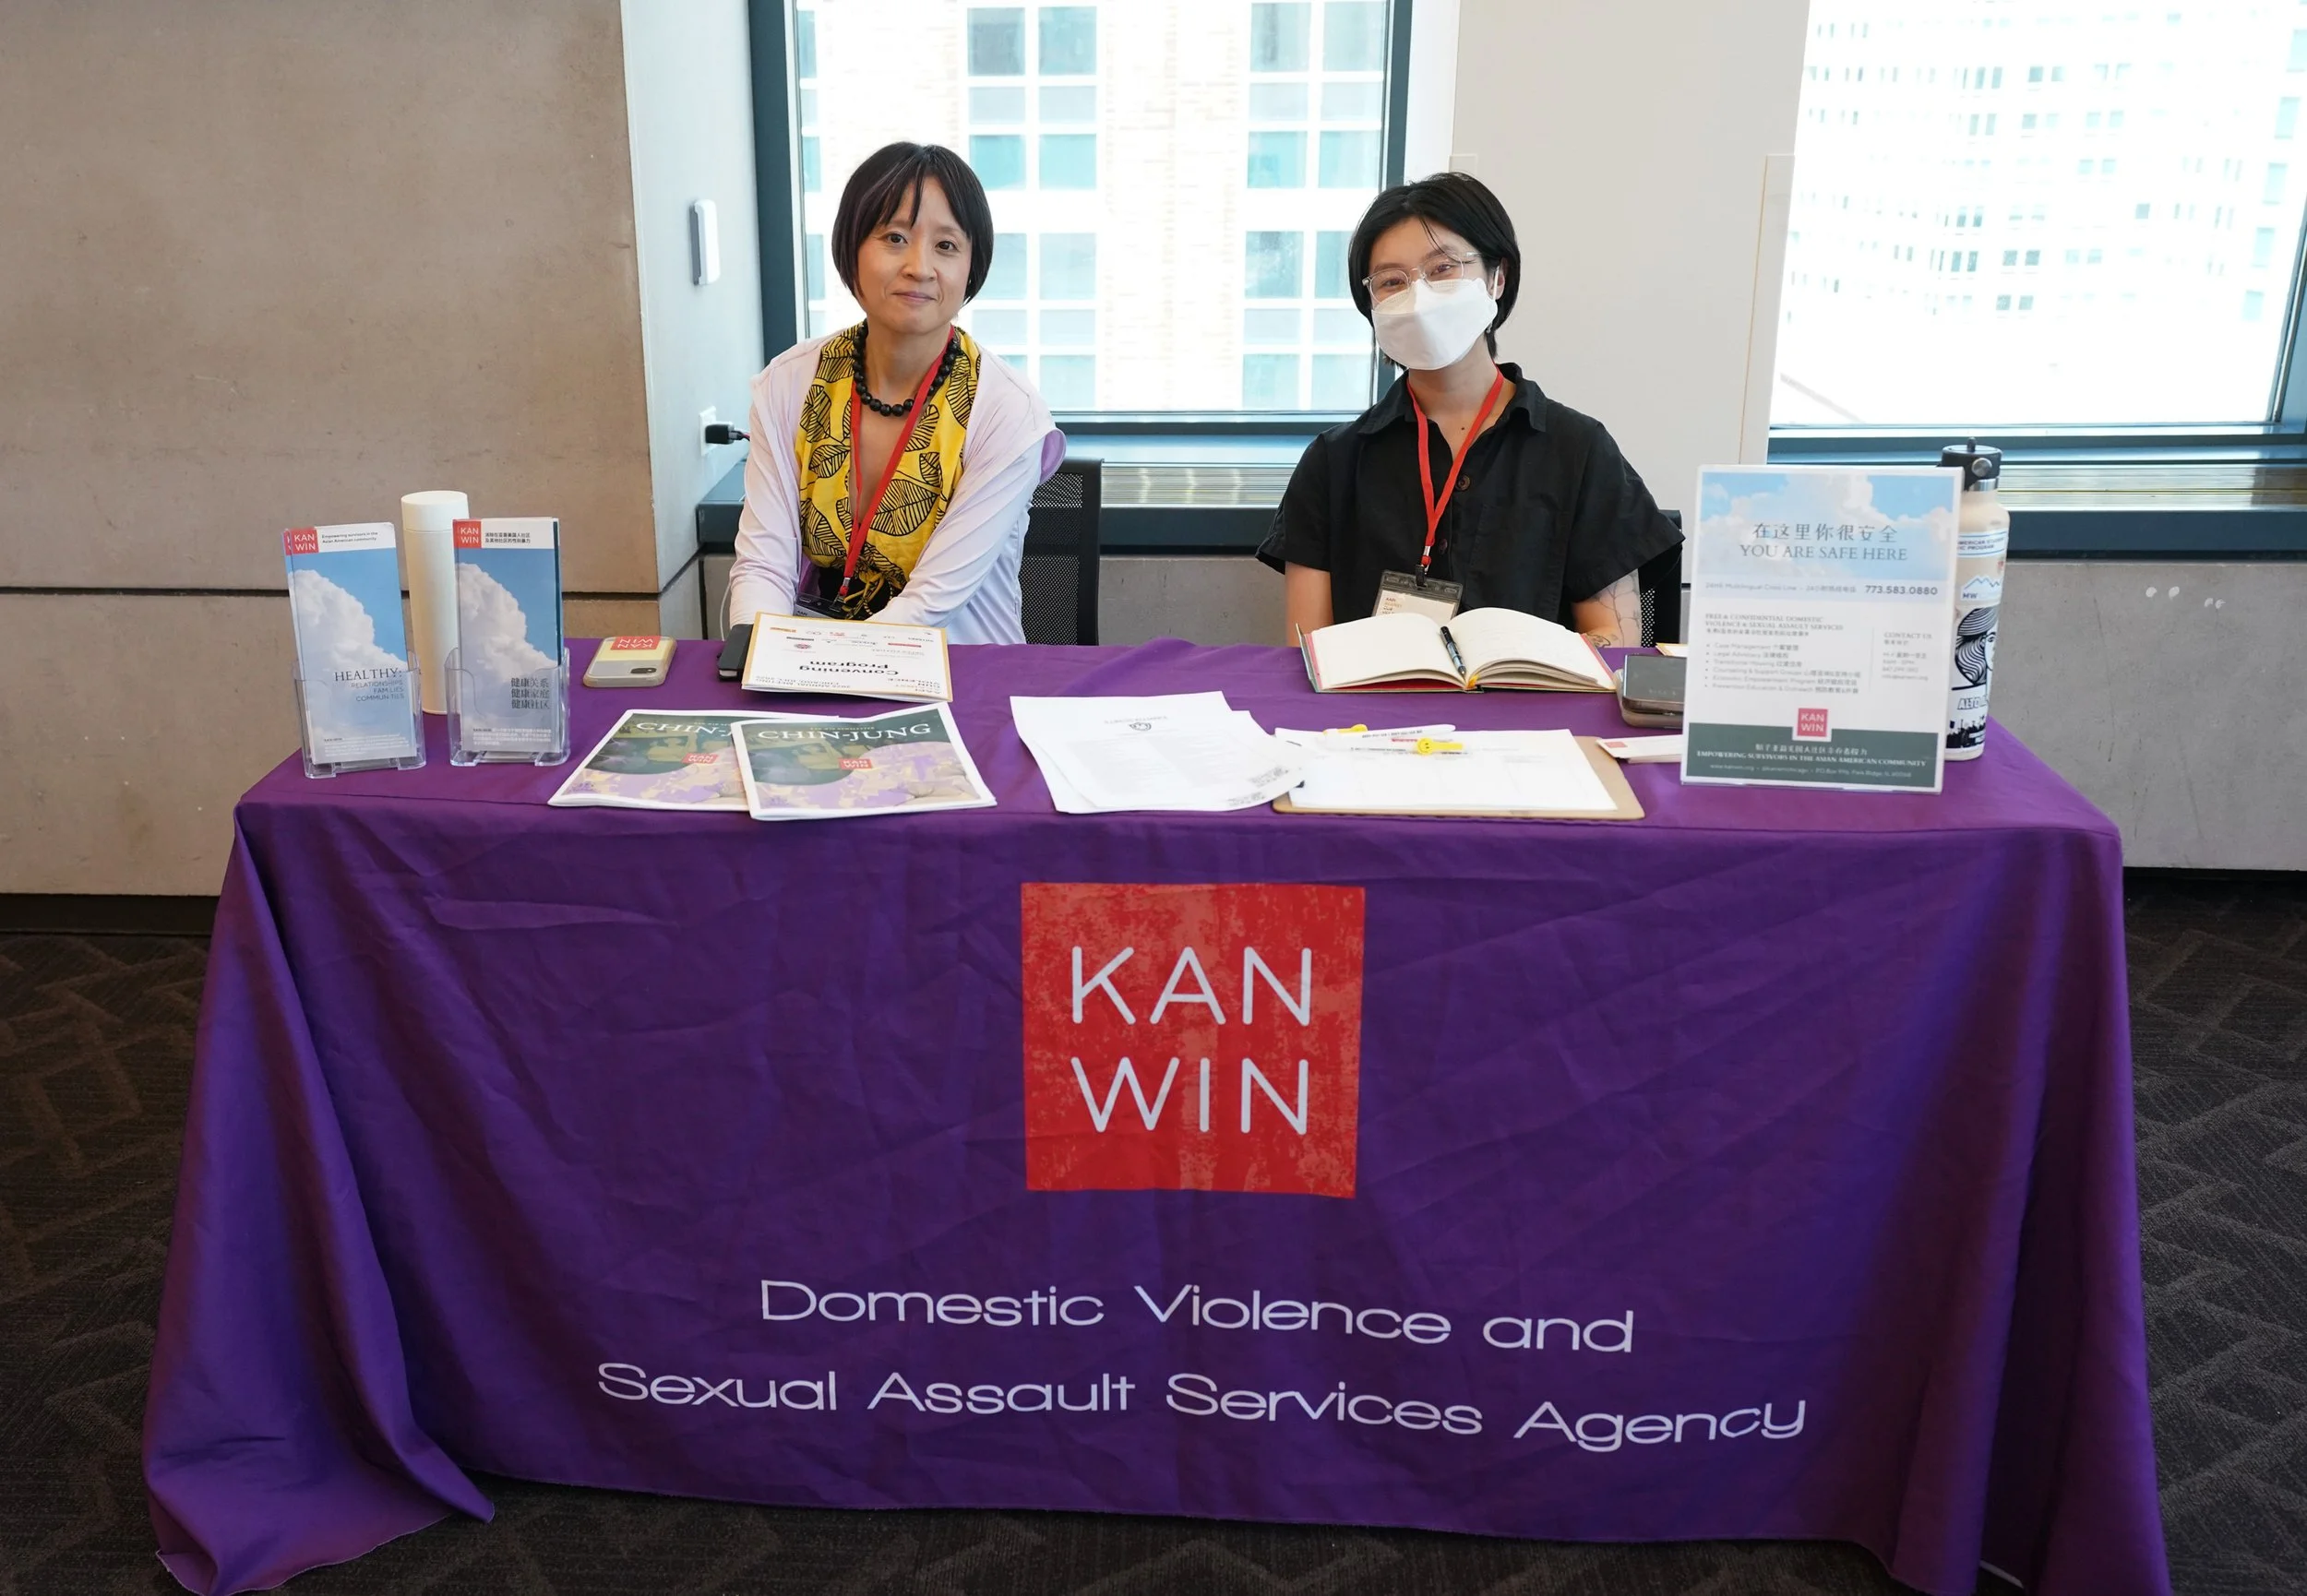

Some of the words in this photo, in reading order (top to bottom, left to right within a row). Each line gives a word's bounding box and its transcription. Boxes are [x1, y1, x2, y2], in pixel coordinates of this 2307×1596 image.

[460, 527, 479, 535] KAN
[1752, 523, 1898, 543] 在这里你很安全
[294, 533, 315, 542] KAN
[460, 536, 479, 544] WIN
[294, 543, 316, 552] WIN
[1739, 543, 1778, 558] YOU
[1782, 545, 1815, 559] ARE
[1819, 546, 1859, 560] SAFE
[1863, 547, 1907, 561] HERE
[1865, 584, 1938, 596] 773.583.0880
[799, 664, 899, 676] Convening
[809, 661, 889, 670] Program
[334, 667, 403, 682] HEALTHY:
[351, 679, 404, 689] RELATIONSHIPS
[510, 677, 549, 688] 健康关系
[510, 687, 550, 698] 健康家庭
[511, 698, 551, 709] 健康社区
[1800, 712, 1825, 722] KAN
[636, 722, 733, 737] CHIN-J
[758, 723, 931, 742] CHIN-JUNG
[1800, 722, 1824, 732] WIN
[1696, 750, 1747, 759] EMPOWERING
[1747, 752, 1788, 762] SURVIVORS
[1799, 755, 1814, 763] THE
[1814, 756, 1837, 764] ASIAN
[1837, 757, 1877, 766] AMERICAN
[1877, 759, 1927, 768] COMMUNITY
[1071, 946, 1312, 1027] KAN
[1070, 1055, 1309, 1136] WIN
[760, 1278, 1106, 1328] Domestic
[1133, 1283, 1452, 1345] Violence
[1482, 1309, 1634, 1353] and
[596, 1362, 838, 1411] Sexual
[867, 1371, 1137, 1416] Assault
[1165, 1373, 1484, 1436] Services
[1512, 1399, 1807, 1453] Agency
